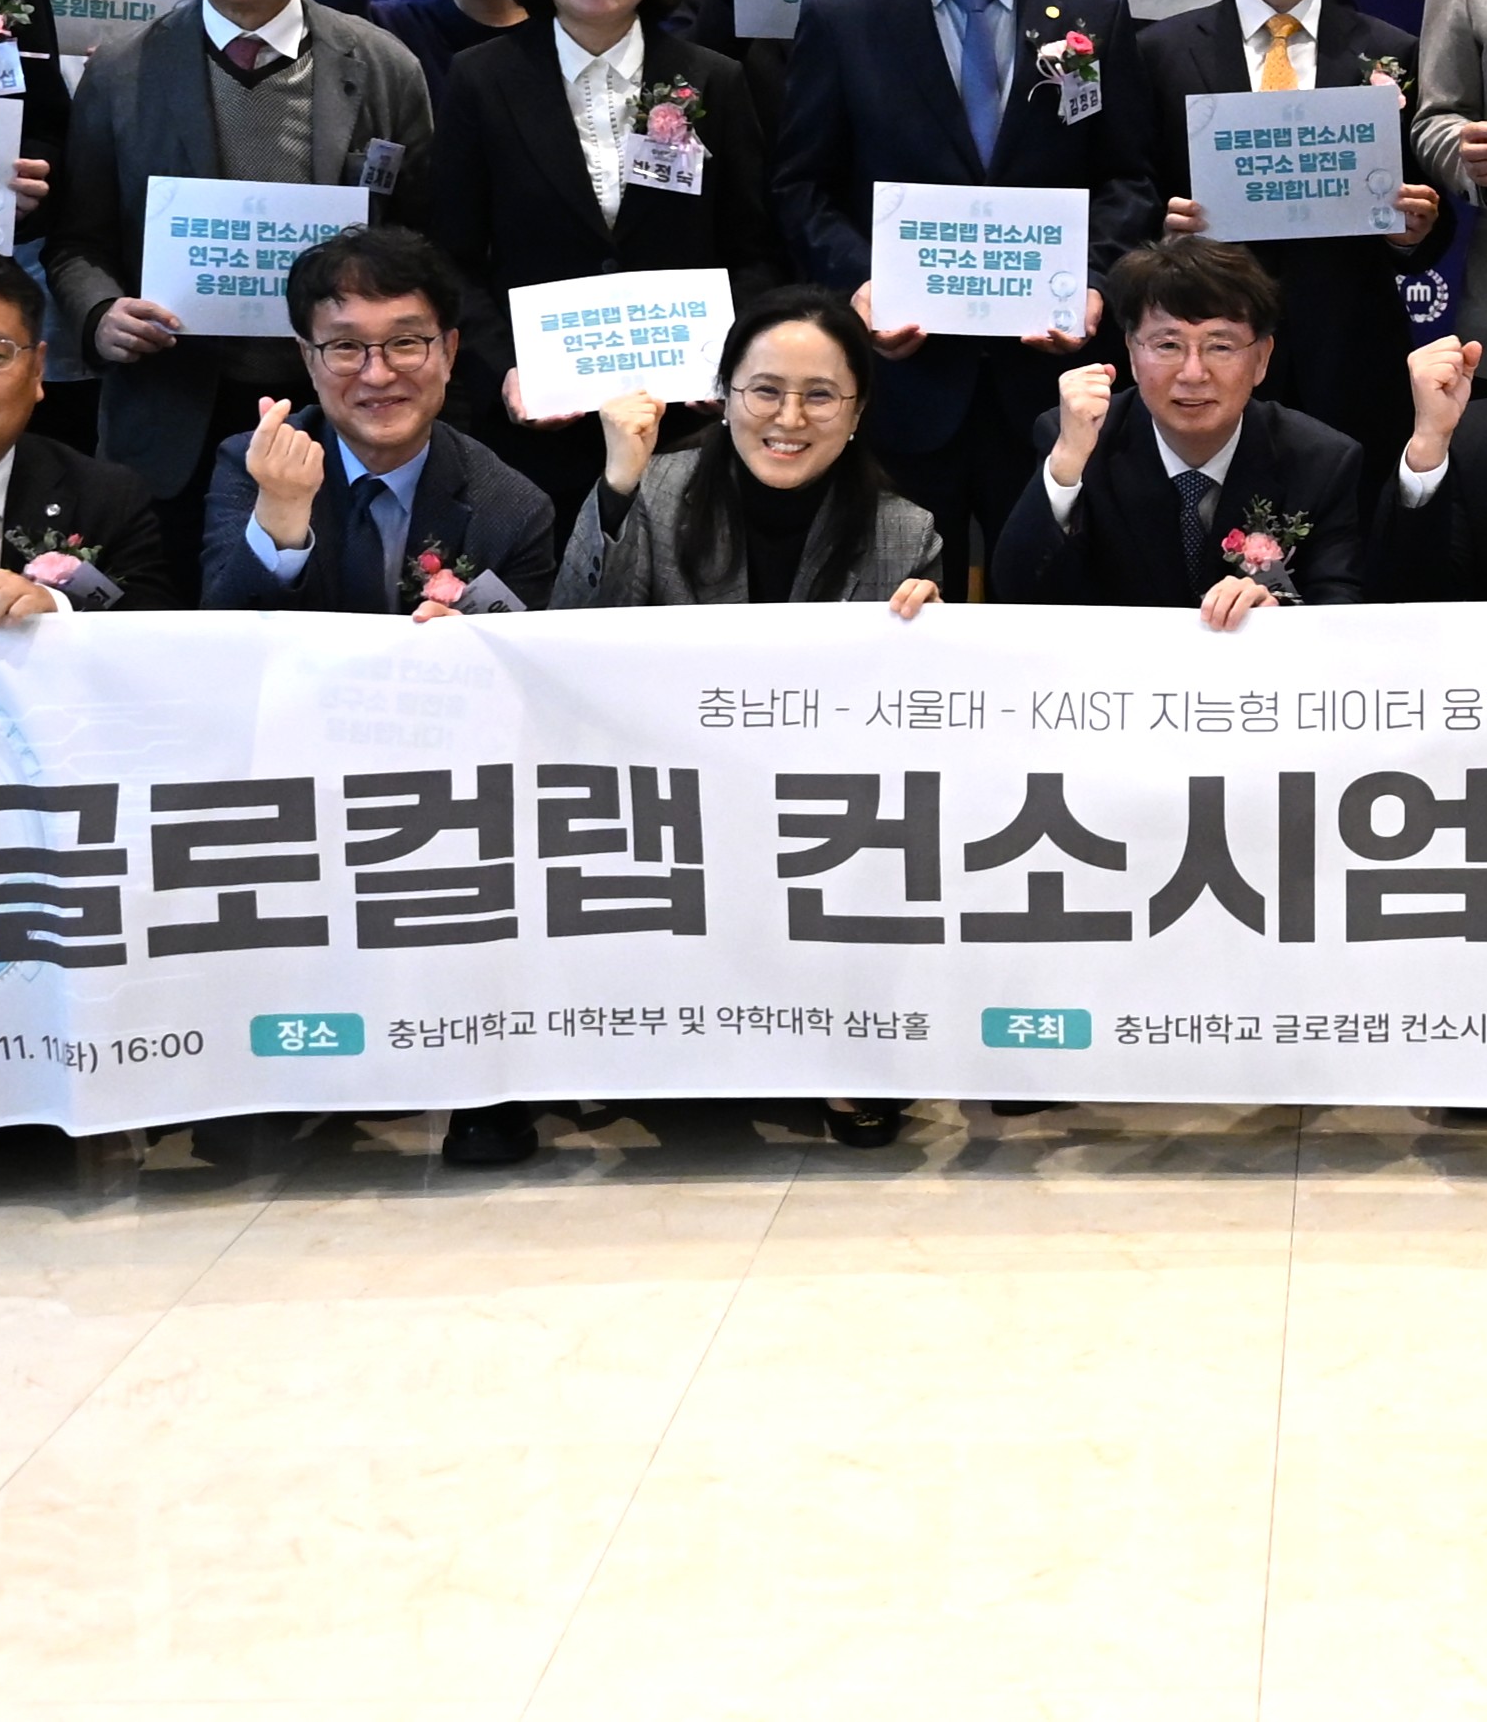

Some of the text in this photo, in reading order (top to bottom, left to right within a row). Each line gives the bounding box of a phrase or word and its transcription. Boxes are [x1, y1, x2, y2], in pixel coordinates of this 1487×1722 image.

[1213, 123, 1376, 152] 글로컬랩 컨소시엄
[1234, 149, 1358, 177] 연구소 발전을
[1244, 177, 1350, 203] 응원합니다!
[898, 219, 1063, 246] 글로컬랩 컨소시엄
[918, 247, 1043, 272] 연구소 발전을
[926, 273, 1033, 297] 응원합니다!
[540, 300, 708, 333] 글로컬랩 컨소시엄
[563, 324, 691, 353] 연구소 발전을
[576, 348, 684, 376] 응원합니다!
[698, 687, 818, 728] 충남대
[866, 690, 984, 729] 서울대
[1033, 691, 1134, 731] KAIST
[1150, 691, 1278, 732] 지능형
[1298, 689, 1423, 731] 데이터
[276, 1006, 930, 1052] 장소 충남대학교 대학본부 및 약학대학 삼남홀
[1006, 1013, 1068, 1046] 주최
[1115, 1014, 1262, 1044] 충남대학교
[1273, 1013, 1388, 1043] 글로컬랩
[111, 1031, 203, 1064] 16:00
